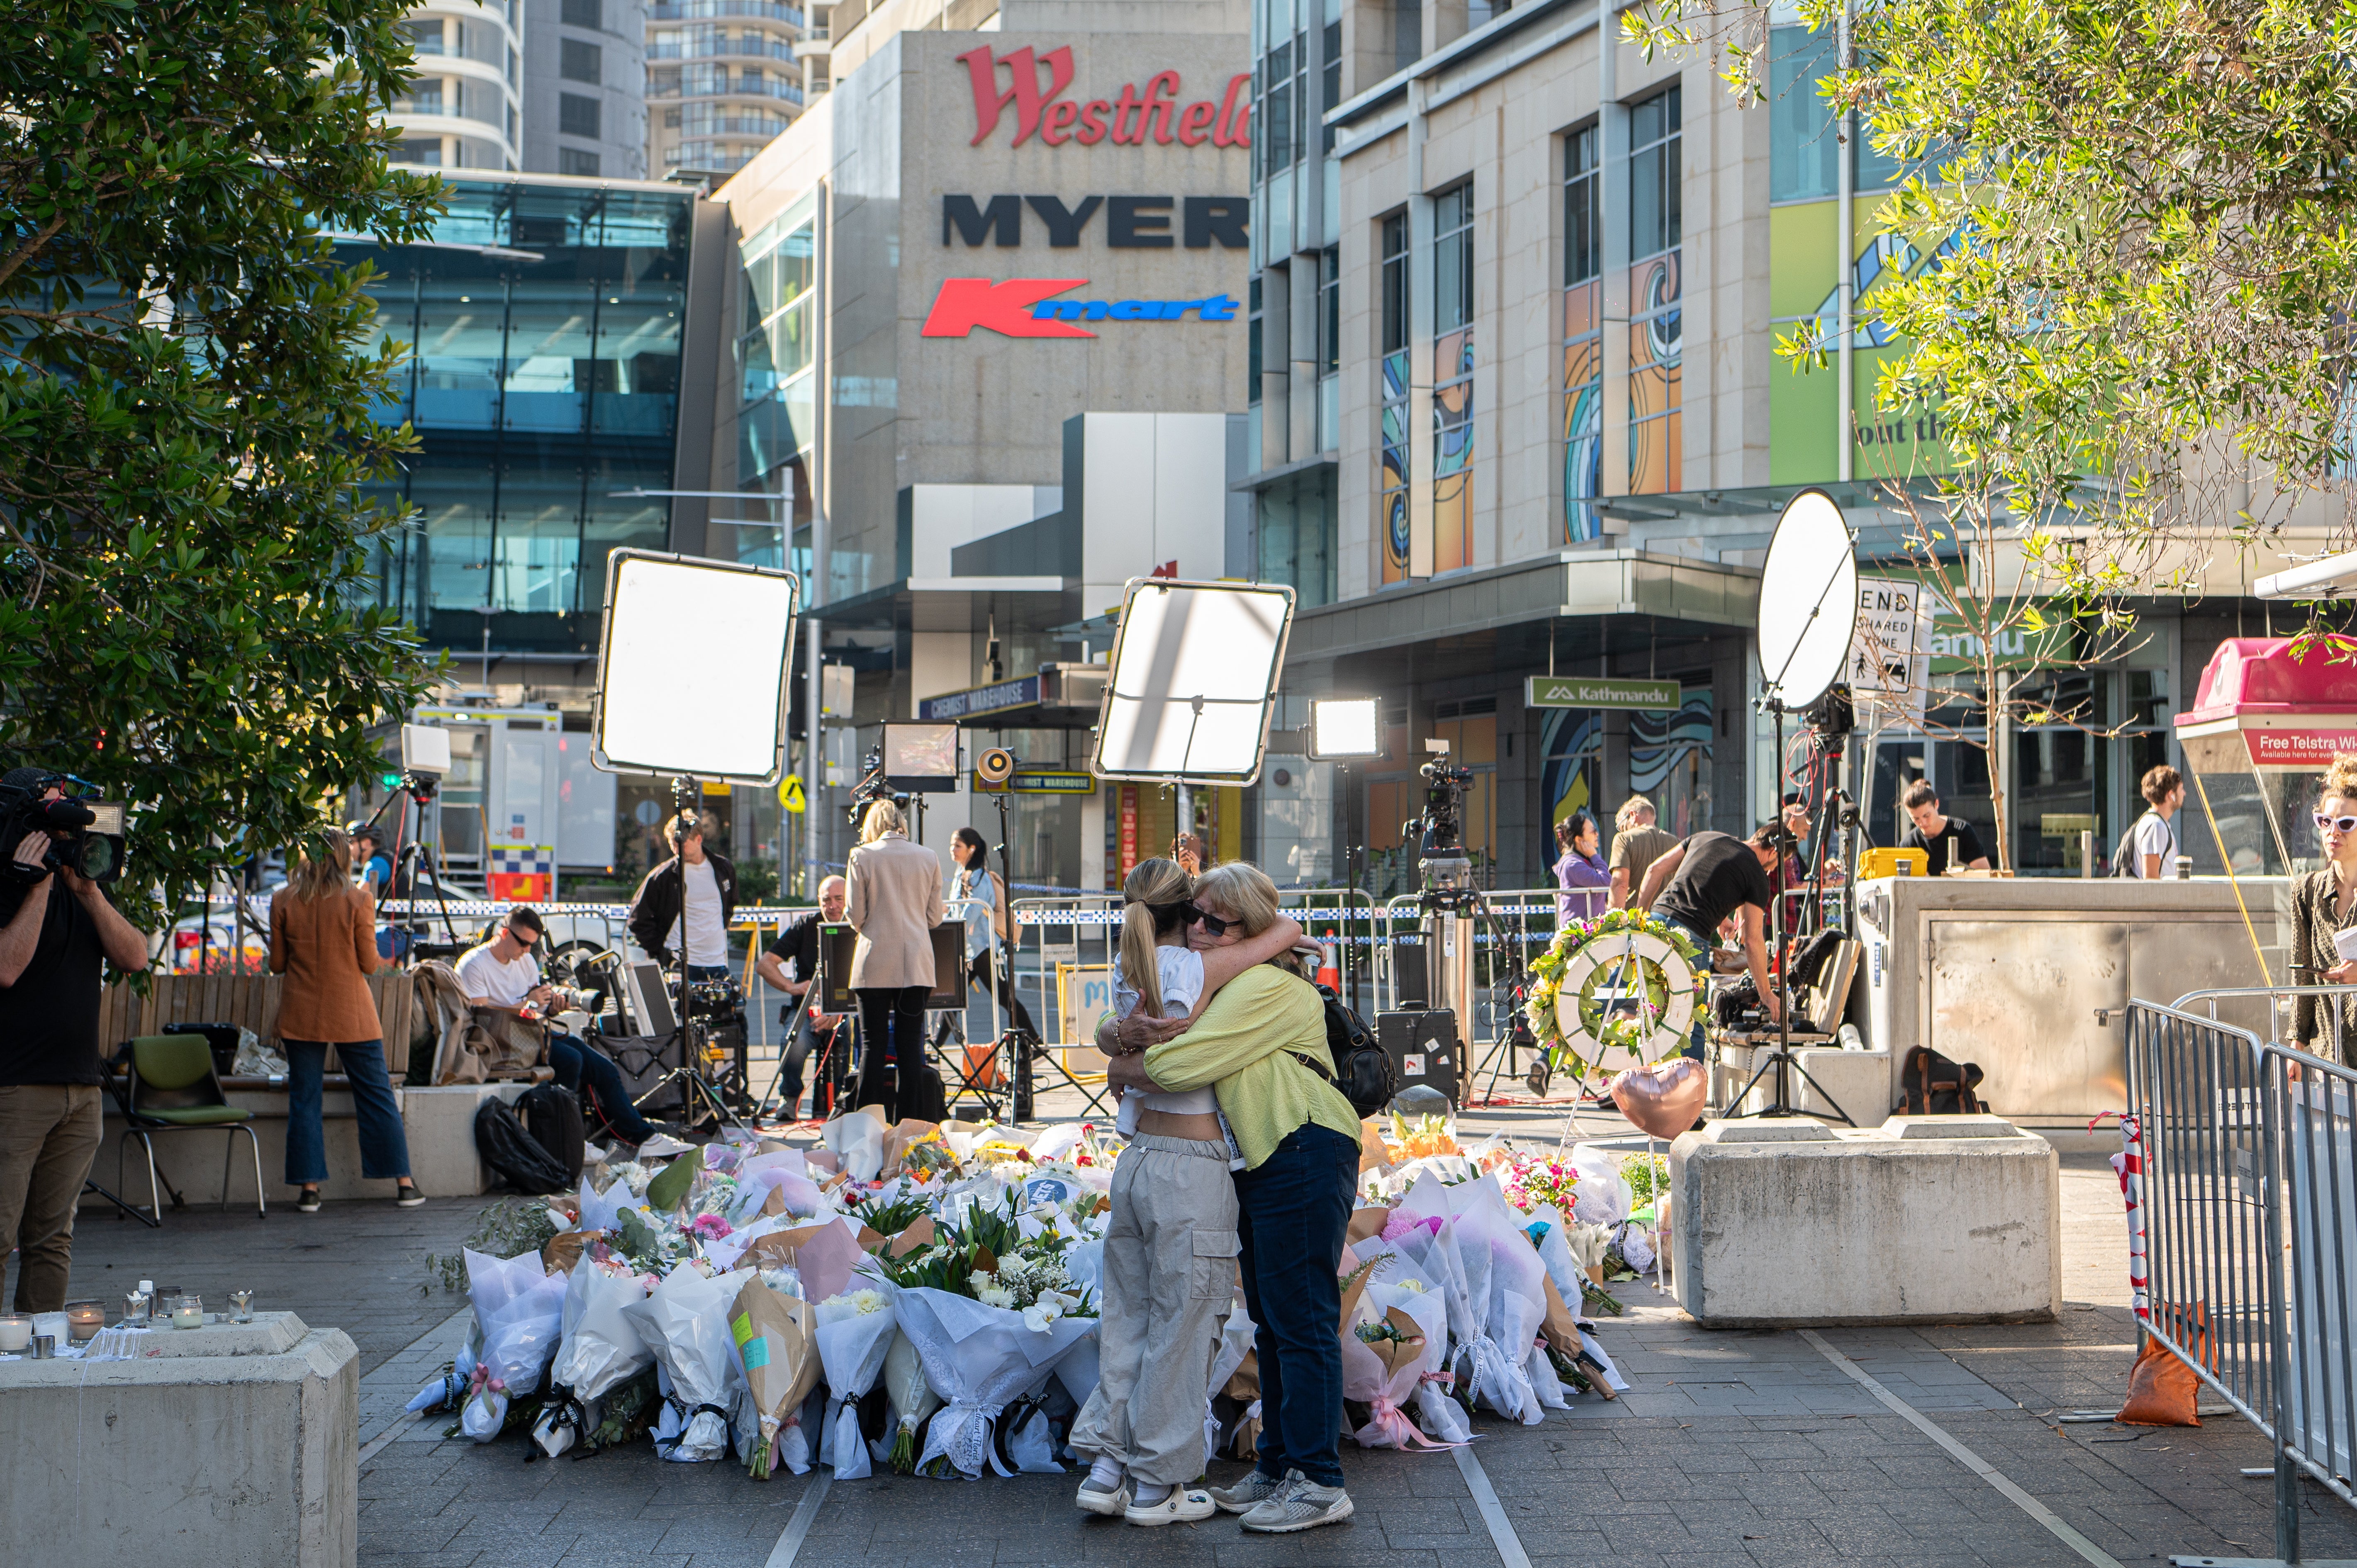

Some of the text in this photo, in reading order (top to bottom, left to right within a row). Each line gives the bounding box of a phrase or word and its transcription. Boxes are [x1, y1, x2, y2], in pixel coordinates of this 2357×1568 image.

[943, 195, 1249, 248] MYER
[921, 278, 1240, 337] Kmart
[1858, 418, 1906, 447] out
[1861, 590, 1909, 612] END
[1858, 618, 1907, 633] SHARED
[930, 681, 1023, 719] CHEMIST WAREHOUSE
[1579, 686, 1669, 703] Kathmandu
[2260, 735, 2289, 750] Free
[2291, 735, 2336, 750] Telstra
[1043, 777, 1089, 788] WAREHOUSE
[1030, 1181, 1055, 1204] JETS
[1468, 1363, 1483, 1398] Sweetheart
[443, 1377, 454, 1410] Sweetheart
[972, 1437, 982, 1461] Florist
